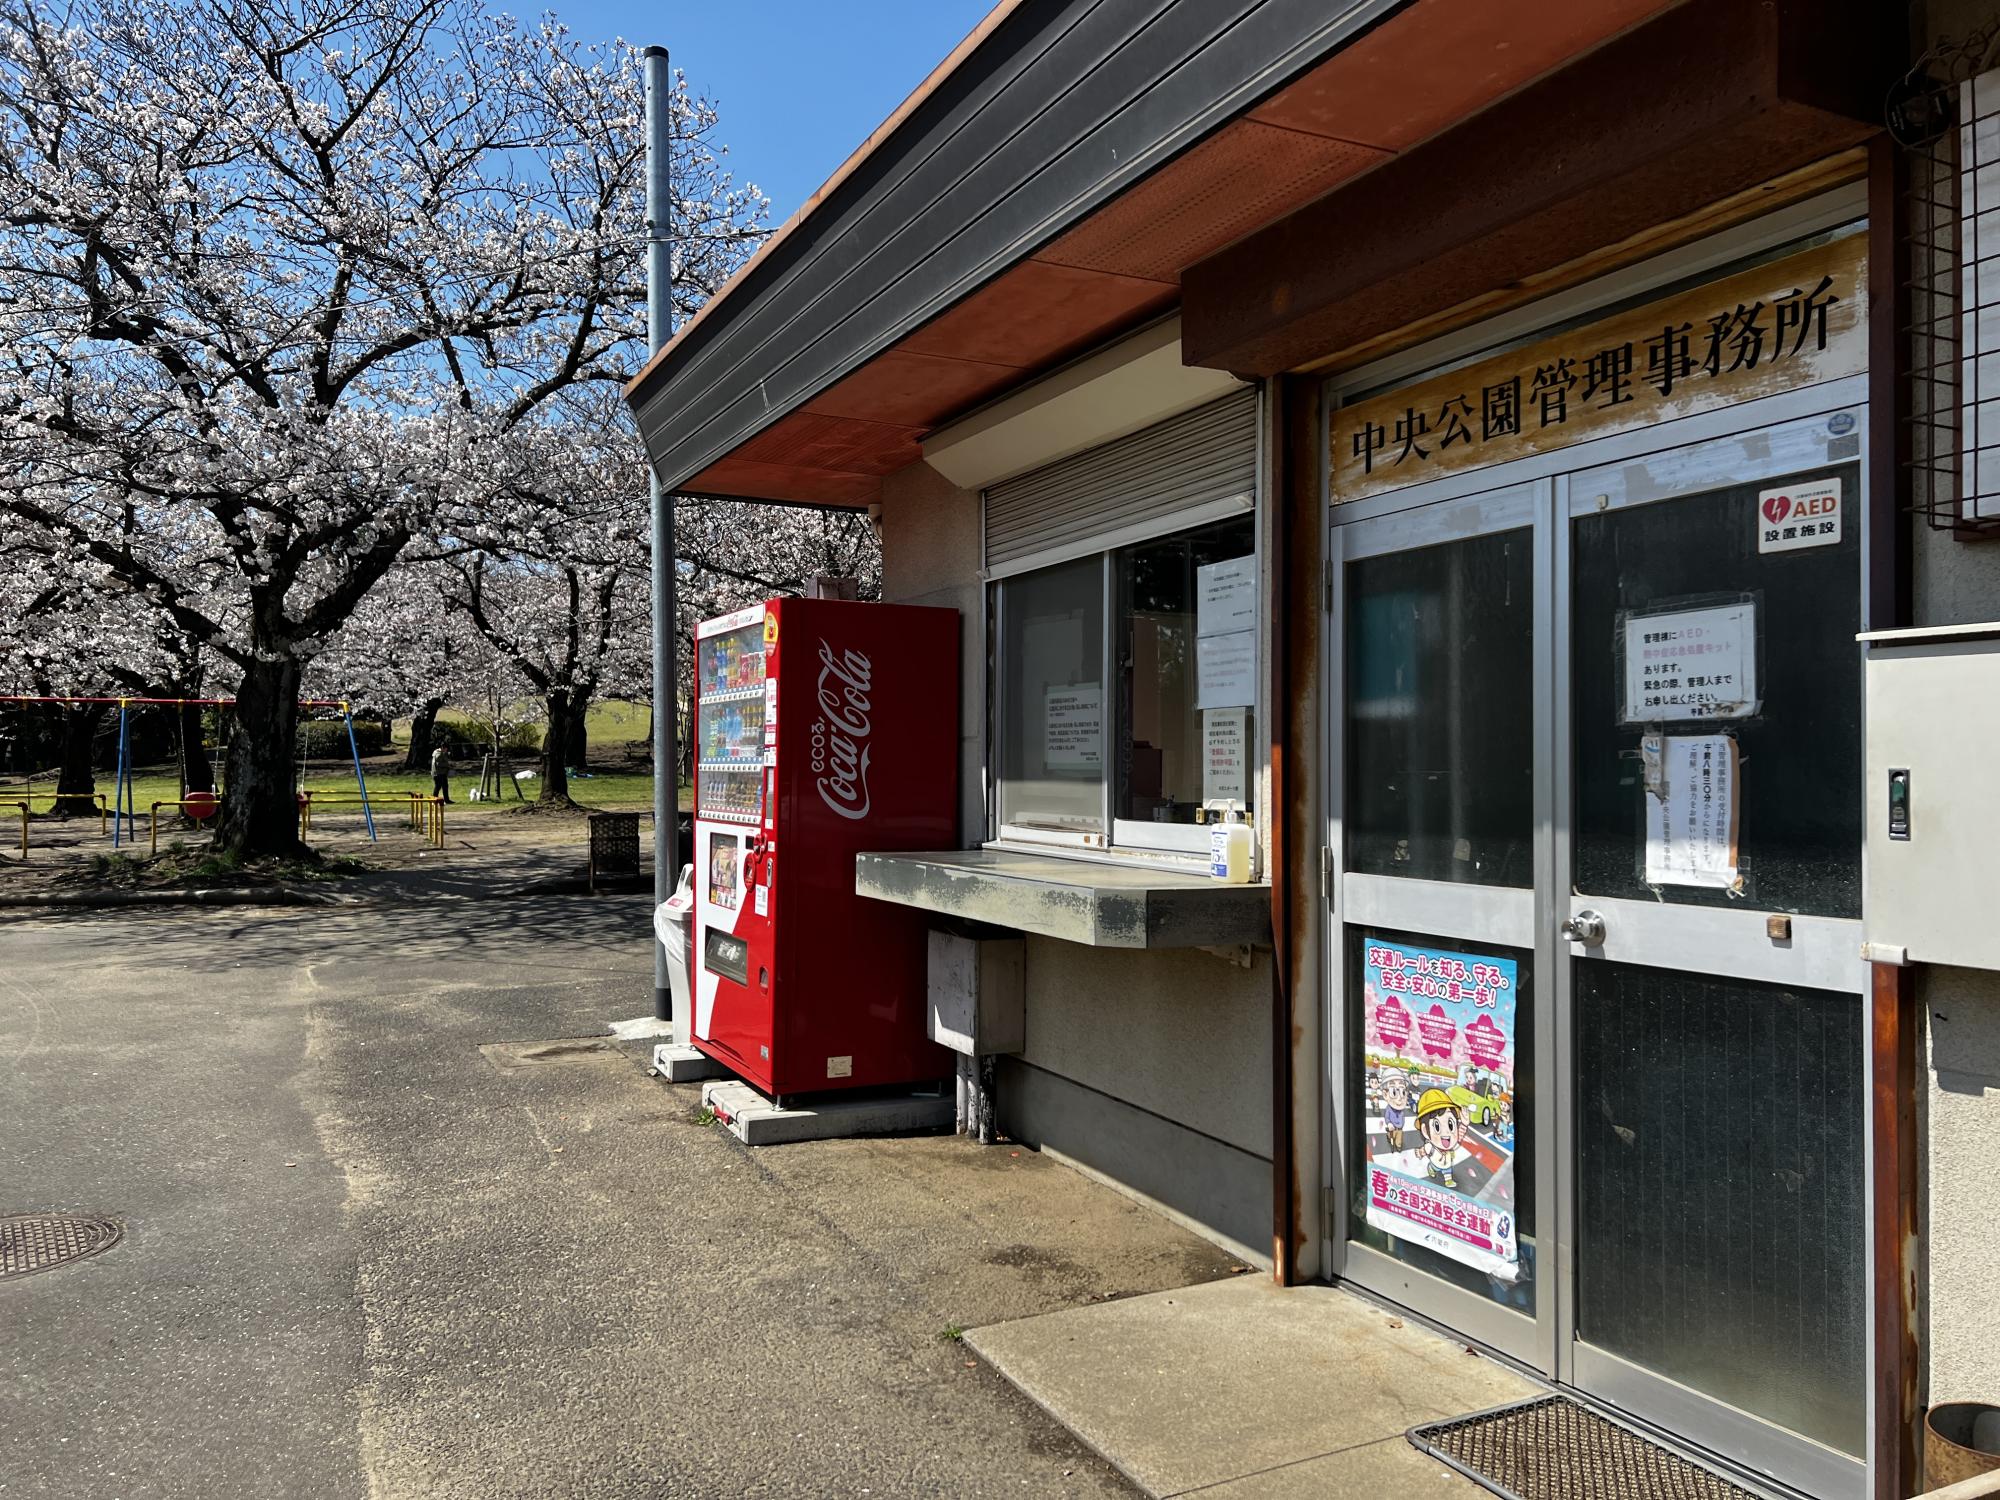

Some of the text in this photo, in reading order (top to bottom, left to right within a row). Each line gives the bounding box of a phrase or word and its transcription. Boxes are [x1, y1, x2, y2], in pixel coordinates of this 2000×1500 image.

[1352, 275, 1840, 475] 中央公園管理事務所
[1792, 496, 1837, 518] AED
[1764, 521, 1835, 543] 設置施設
[1644, 662, 1683, 676] あります。
[1644, 691, 1719, 707] お申し出ください。
[816, 636, 872, 820] Coca-Cola
[1368, 946, 1510, 990] 交通ルールを知る、守る。
[1380, 968, 1498, 1008] 安全・安心の第一歩!
[1371, 1169, 1492, 1237] 春の全国交通安全運動
